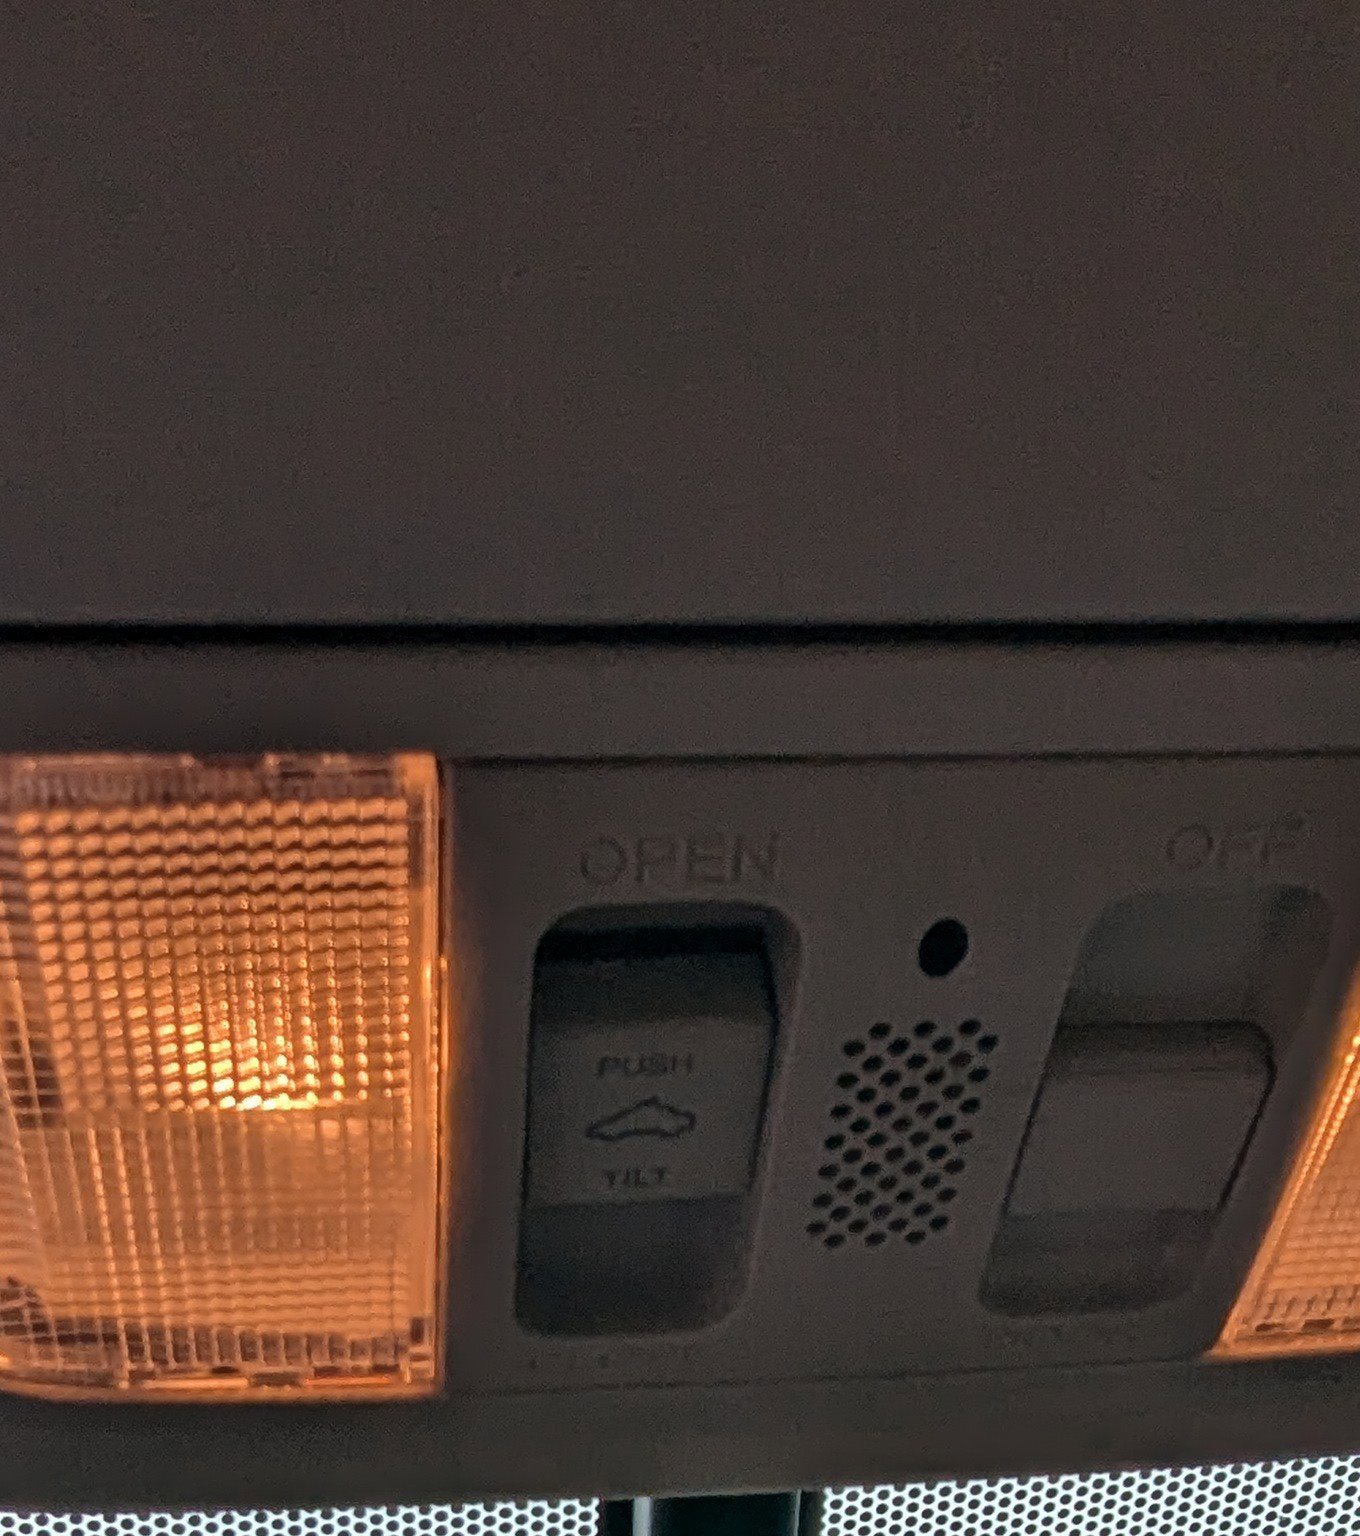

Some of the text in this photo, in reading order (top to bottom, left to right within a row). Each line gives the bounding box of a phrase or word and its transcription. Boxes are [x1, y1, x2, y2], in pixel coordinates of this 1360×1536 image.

[580, 835, 778, 884] OPEN
[1165, 813, 1304, 872] OFF
[596, 1053, 695, 1079] PUSH
[601, 1166, 669, 1188] TILT
